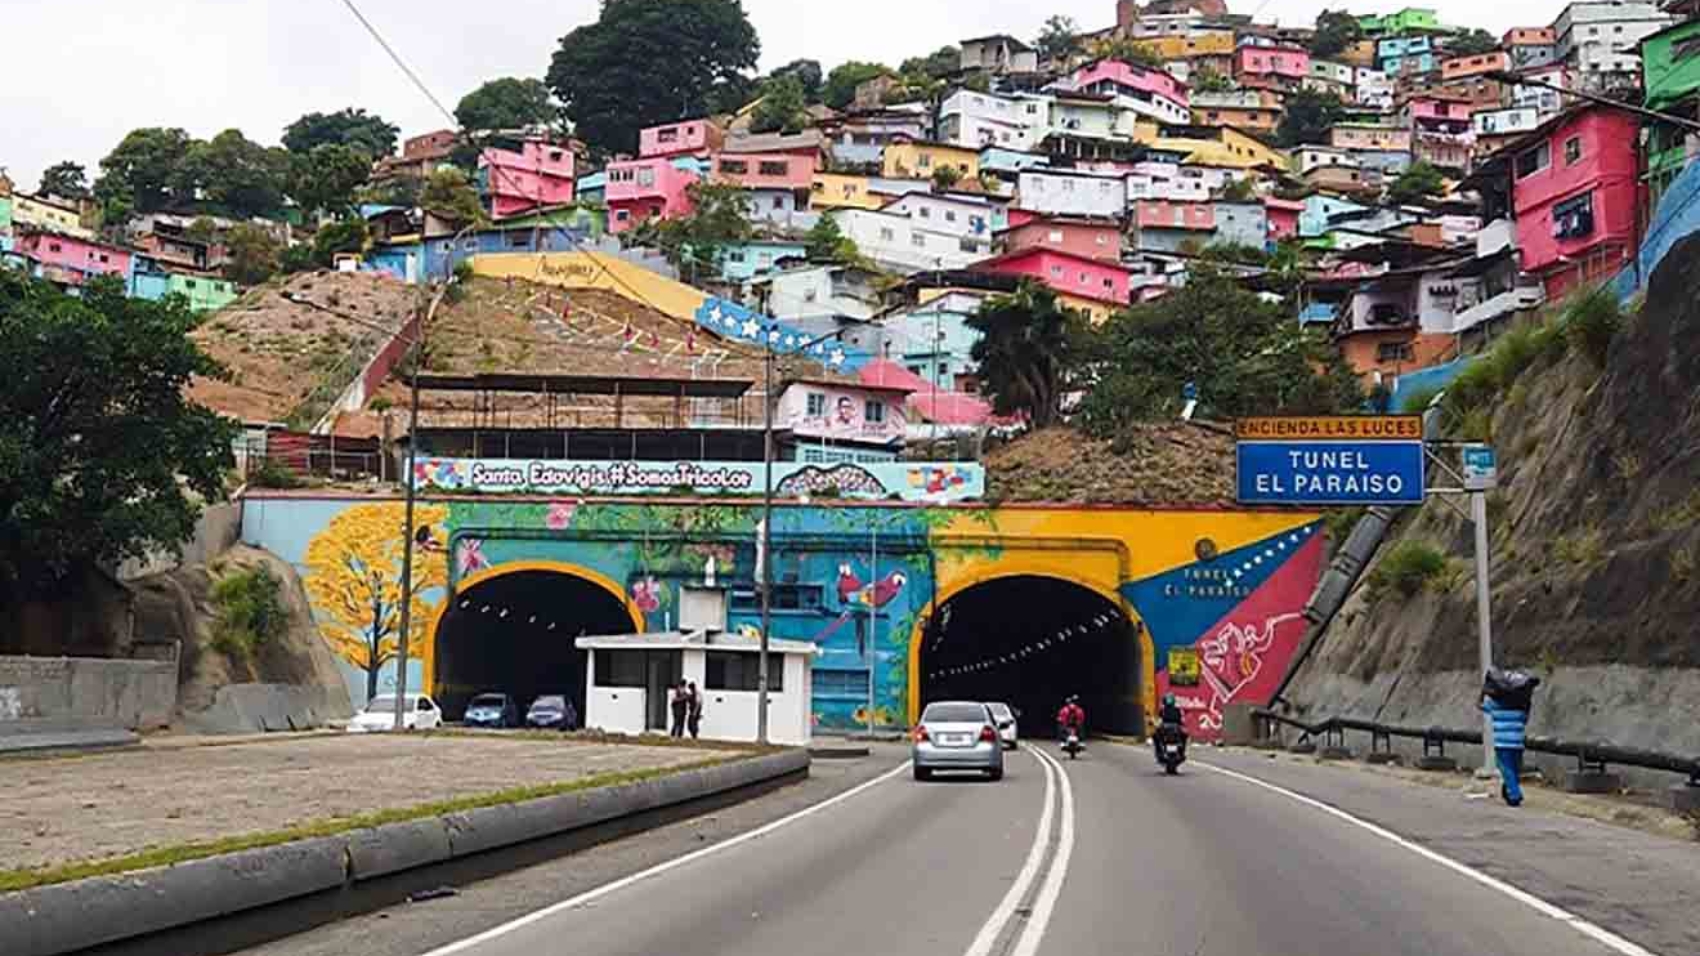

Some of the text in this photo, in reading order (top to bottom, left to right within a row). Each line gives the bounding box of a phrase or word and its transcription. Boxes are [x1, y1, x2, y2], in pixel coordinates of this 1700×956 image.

[1239, 420, 1416, 435] ENCIENDA LAS LUCES
[1289, 450, 1370, 469] TUNEL
[1256, 473, 1403, 494] EL PARAISO
